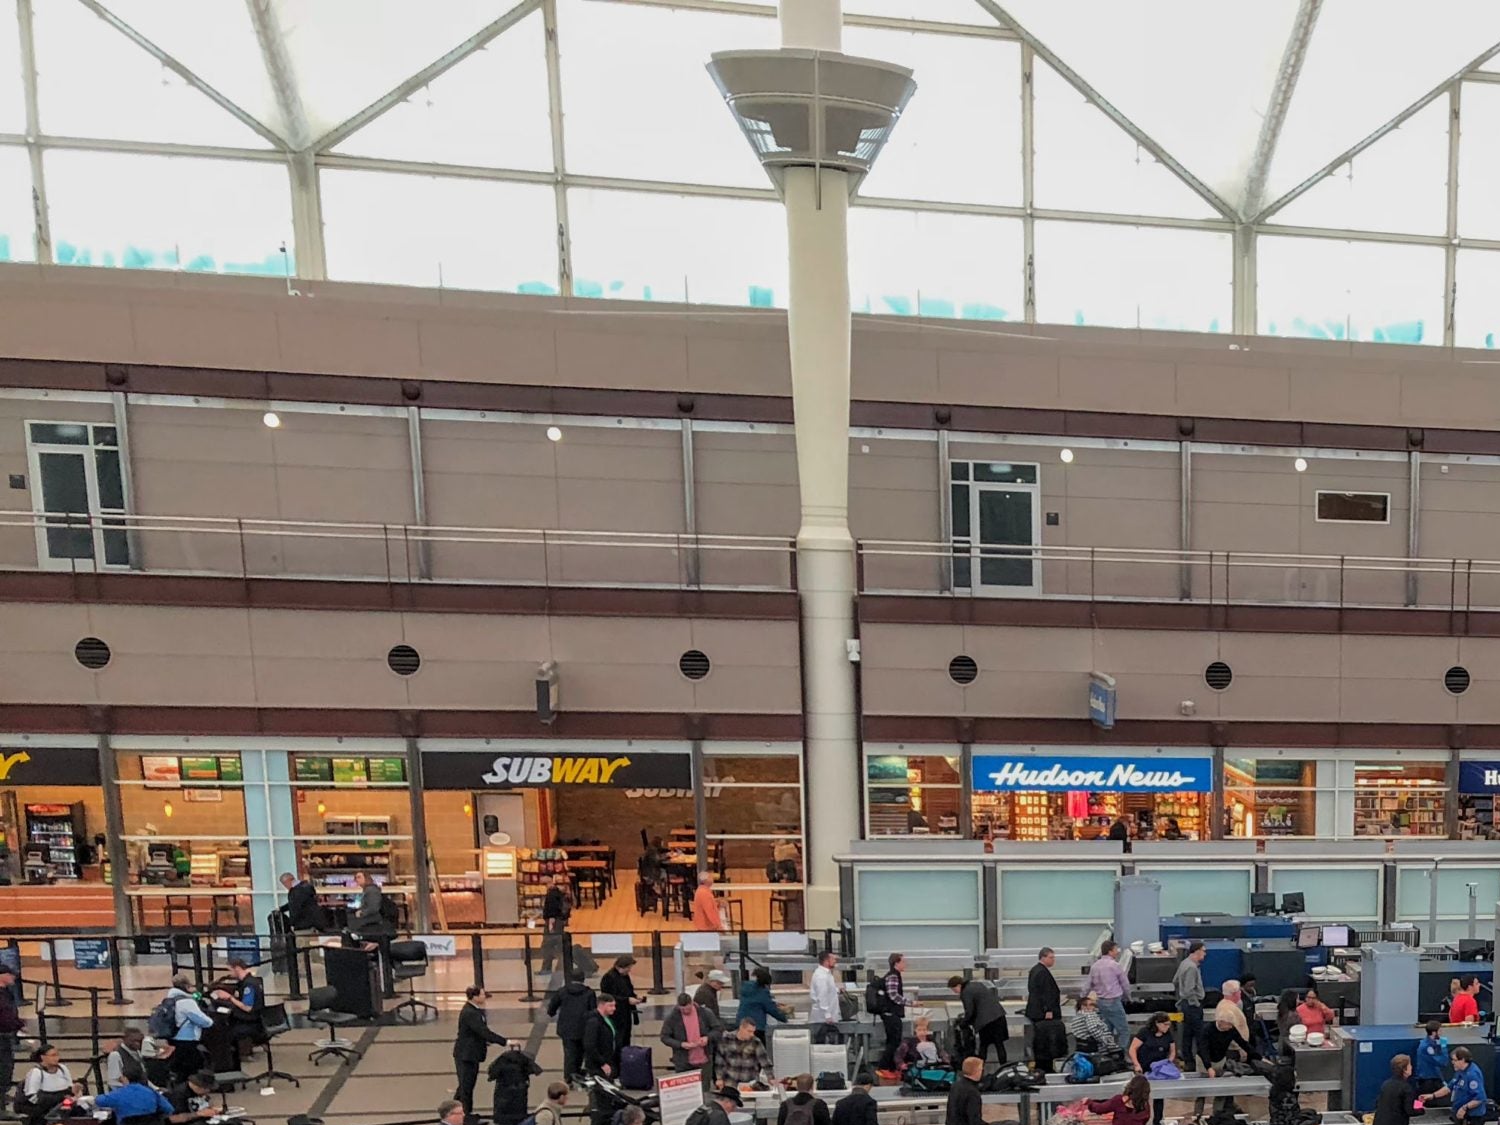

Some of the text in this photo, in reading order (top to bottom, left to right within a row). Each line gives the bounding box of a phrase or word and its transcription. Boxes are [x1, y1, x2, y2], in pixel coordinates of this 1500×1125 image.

[481, 755, 632, 785] SUBWAY
[988, 762, 1196, 788] Hudson News
